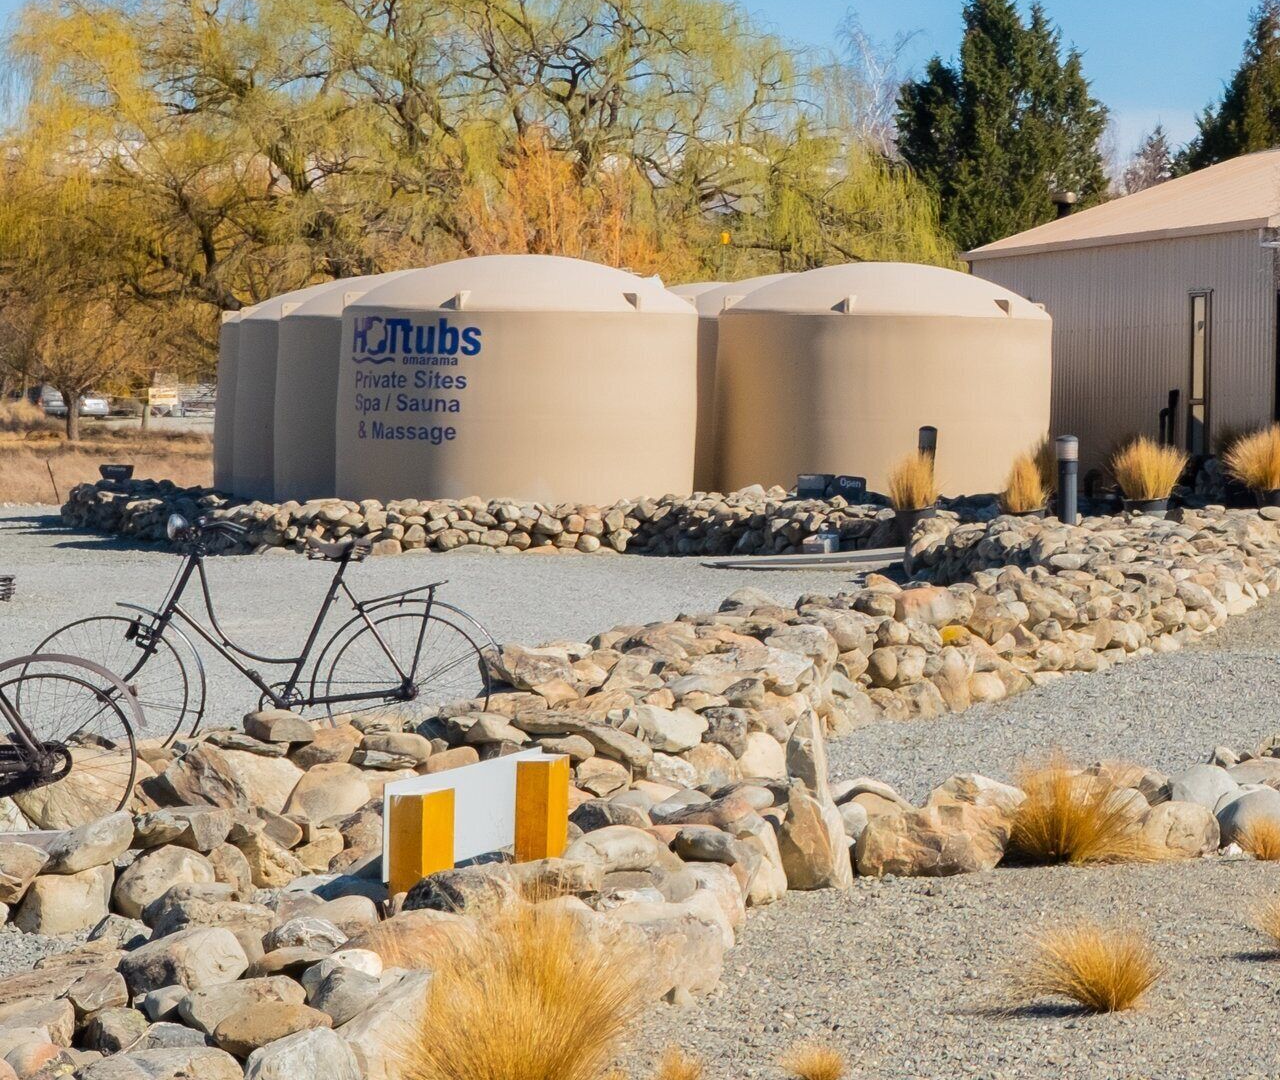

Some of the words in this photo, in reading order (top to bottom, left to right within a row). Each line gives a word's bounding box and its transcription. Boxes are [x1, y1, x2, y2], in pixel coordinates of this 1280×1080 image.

[402, 355, 459, 366] omarama
[355, 370, 407, 389] Private
[414, 370, 468, 389] Sites
[355, 393, 380, 415] Spa
[396, 393, 460, 412] Sauna
[358, 420, 367, 439] &
[372, 421, 456, 445] Massage
[840, 478, 861, 488] Open
